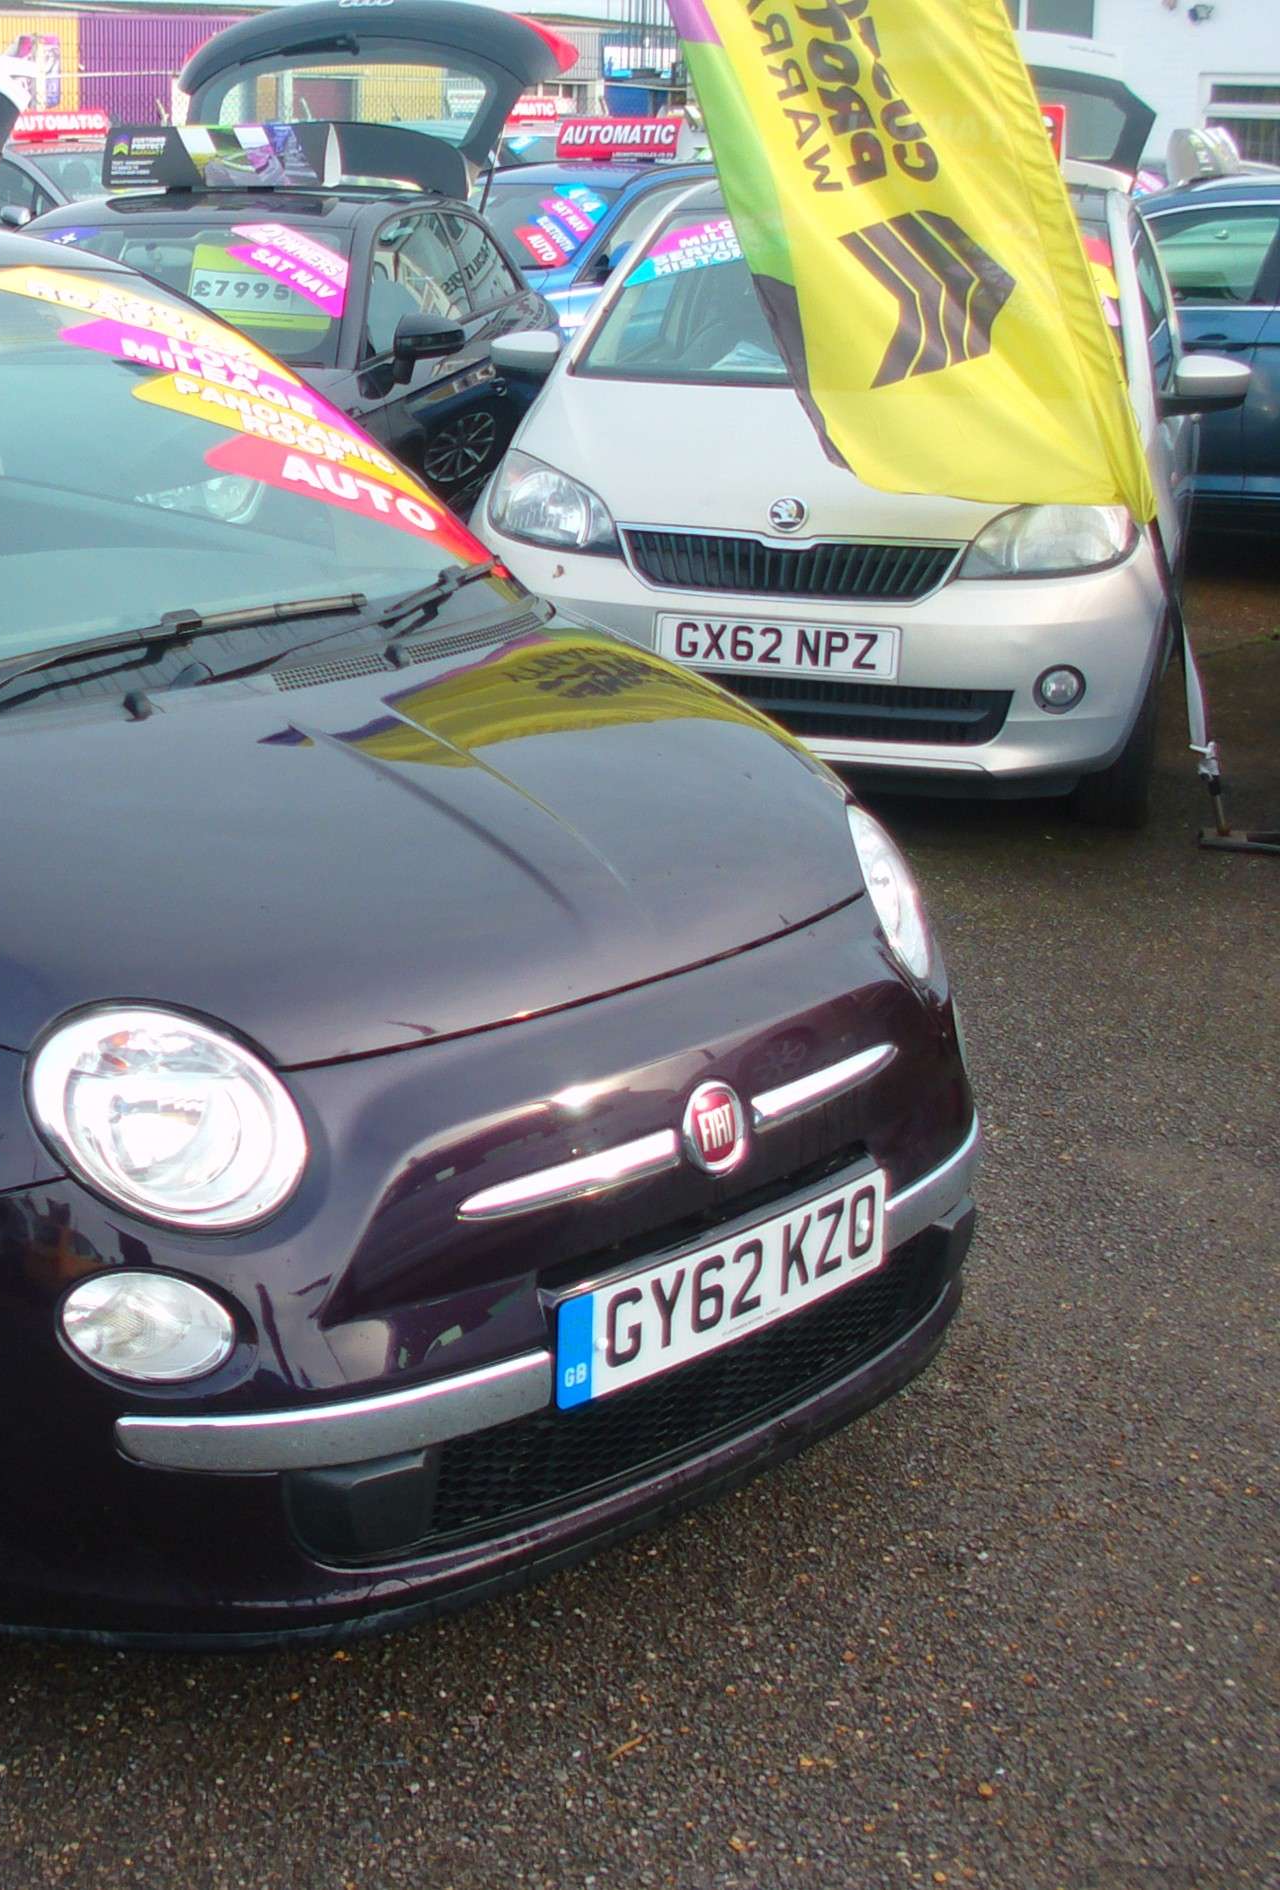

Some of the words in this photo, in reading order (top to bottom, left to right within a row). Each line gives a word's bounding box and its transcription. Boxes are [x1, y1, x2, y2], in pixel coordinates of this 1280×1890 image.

[14, 113, 105, 132] AUTOMATIC
[560, 123, 676, 145] AUTOMATIC
[552, 200, 574, 217] SAT
[273, 231, 345, 278] OWNERS
[527, 233, 558, 262] AUTO
[192, 279, 290, 300] £7995
[250, 247, 297, 273] SAT
[289, 268, 337, 299] NAV
[121, 338, 318, 420] MILEAGE
[166, 336, 260, 382] LOW
[173, 375, 396, 476] PANORAMIC
[240, 413, 348, 462] ROOF
[281, 454, 438, 532] AUTO
[675, 621, 783, 663] GX62
[795, 629, 879, 670] NPZ
[696, 1103, 734, 1153] FIAT
[606, 1238, 765, 1369] GY62
[780, 1184, 877, 1296] KZO
[564, 1361, 588, 1388] GB
